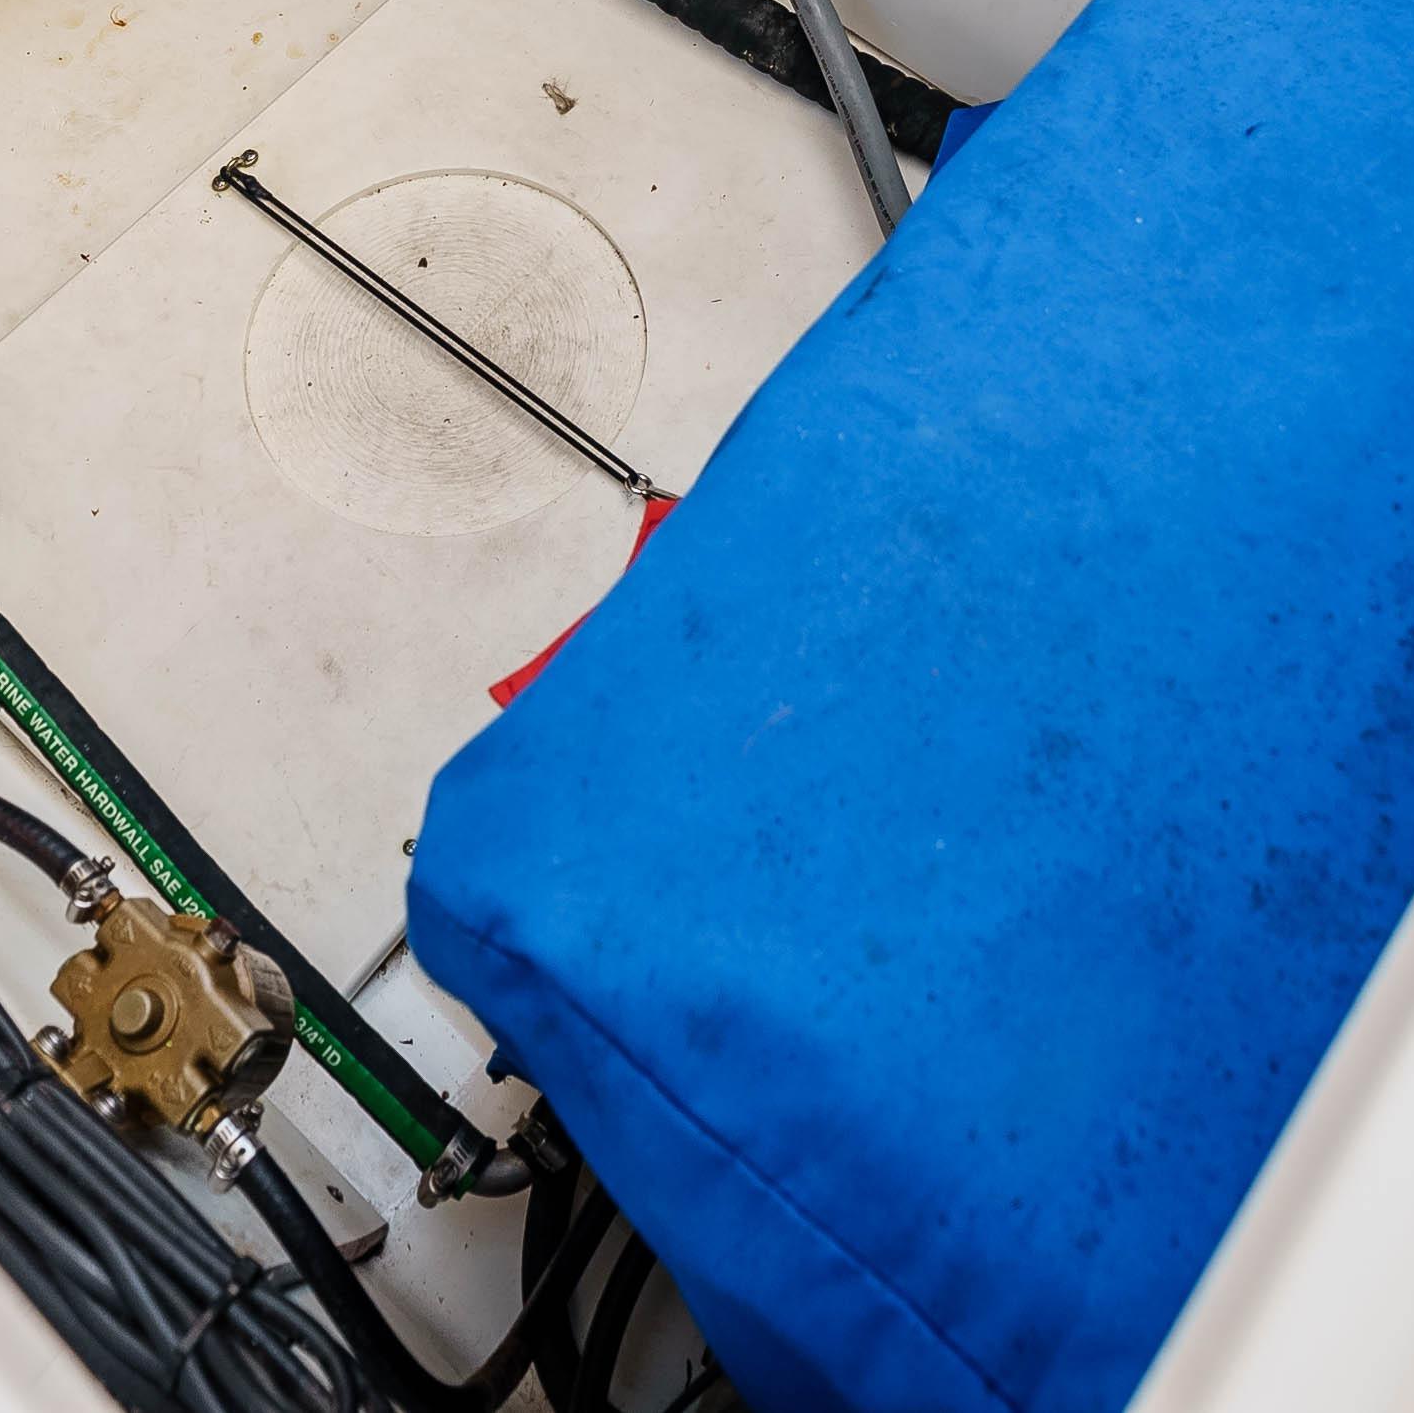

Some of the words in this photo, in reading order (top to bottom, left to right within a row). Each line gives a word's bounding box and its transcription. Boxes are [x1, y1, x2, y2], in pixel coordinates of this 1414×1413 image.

[30, 711, 79, 774] WATER
[75, 767, 149, 863] HARDWALL
[149, 858, 183, 897] SAE
[177, 896, 207, 919] J20
[293, 1015, 325, 1046] 3/4"
[320, 1042, 342, 1068] ID
